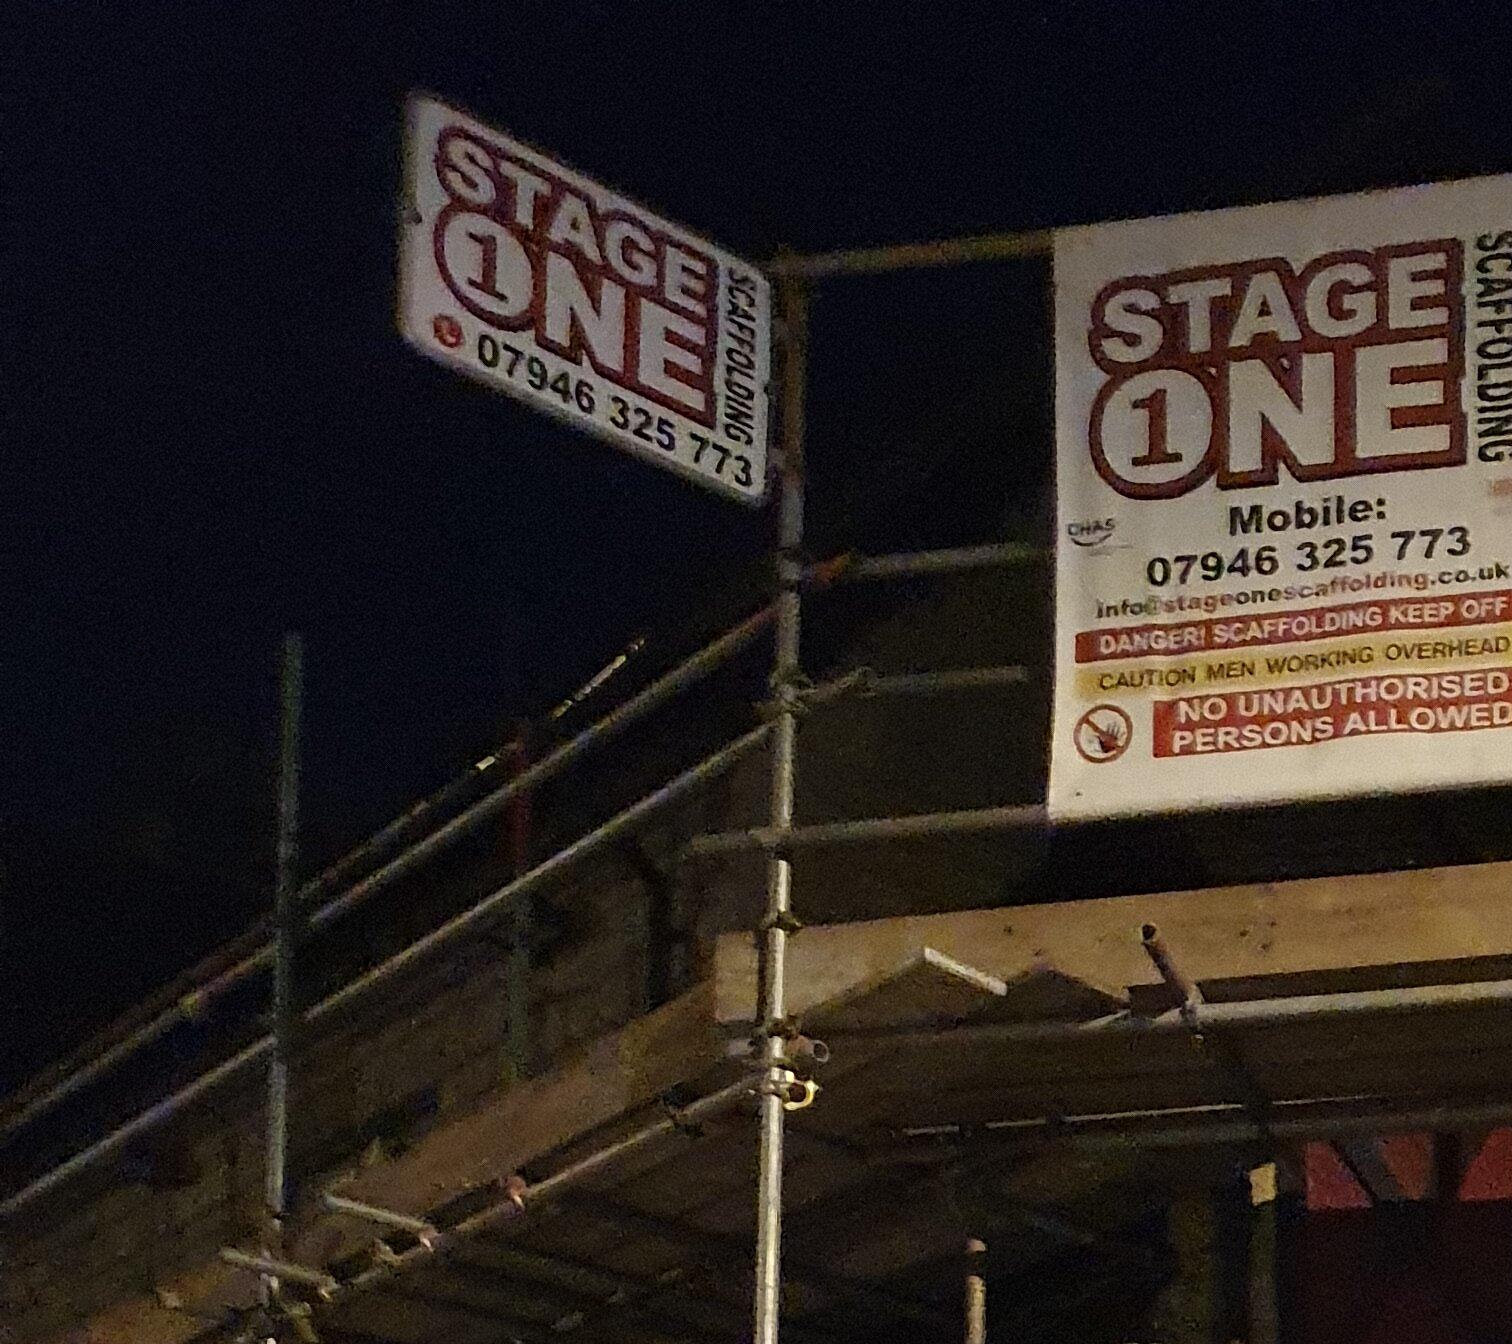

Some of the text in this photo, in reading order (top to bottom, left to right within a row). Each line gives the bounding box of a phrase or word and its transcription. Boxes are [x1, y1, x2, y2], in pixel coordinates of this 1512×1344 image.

[440, 130, 714, 318] STAGE
[1094, 245, 1458, 370] STAGE
[725, 267, 758, 446] SCAFFOLDING
[477, 334, 753, 487] 07946 325 773
[1229, 495, 1387, 536] Mobile:
[1146, 544, 1280, 588] 07946
[1296, 533, 1375, 572] 325
[1390, 526, 1472, 561] 773
[1213, 606, 1384, 644] SCAFFOLDING
[1389, 600, 1456, 625] KEEP
[1461, 595, 1509, 619] OFF
[1099, 636, 1511, 691] CAUTION MEN WORKING OVERHEAD
[1177, 670, 1510, 724] NO UNAUTHORISED
[1171, 714, 1334, 755] PERSONS
